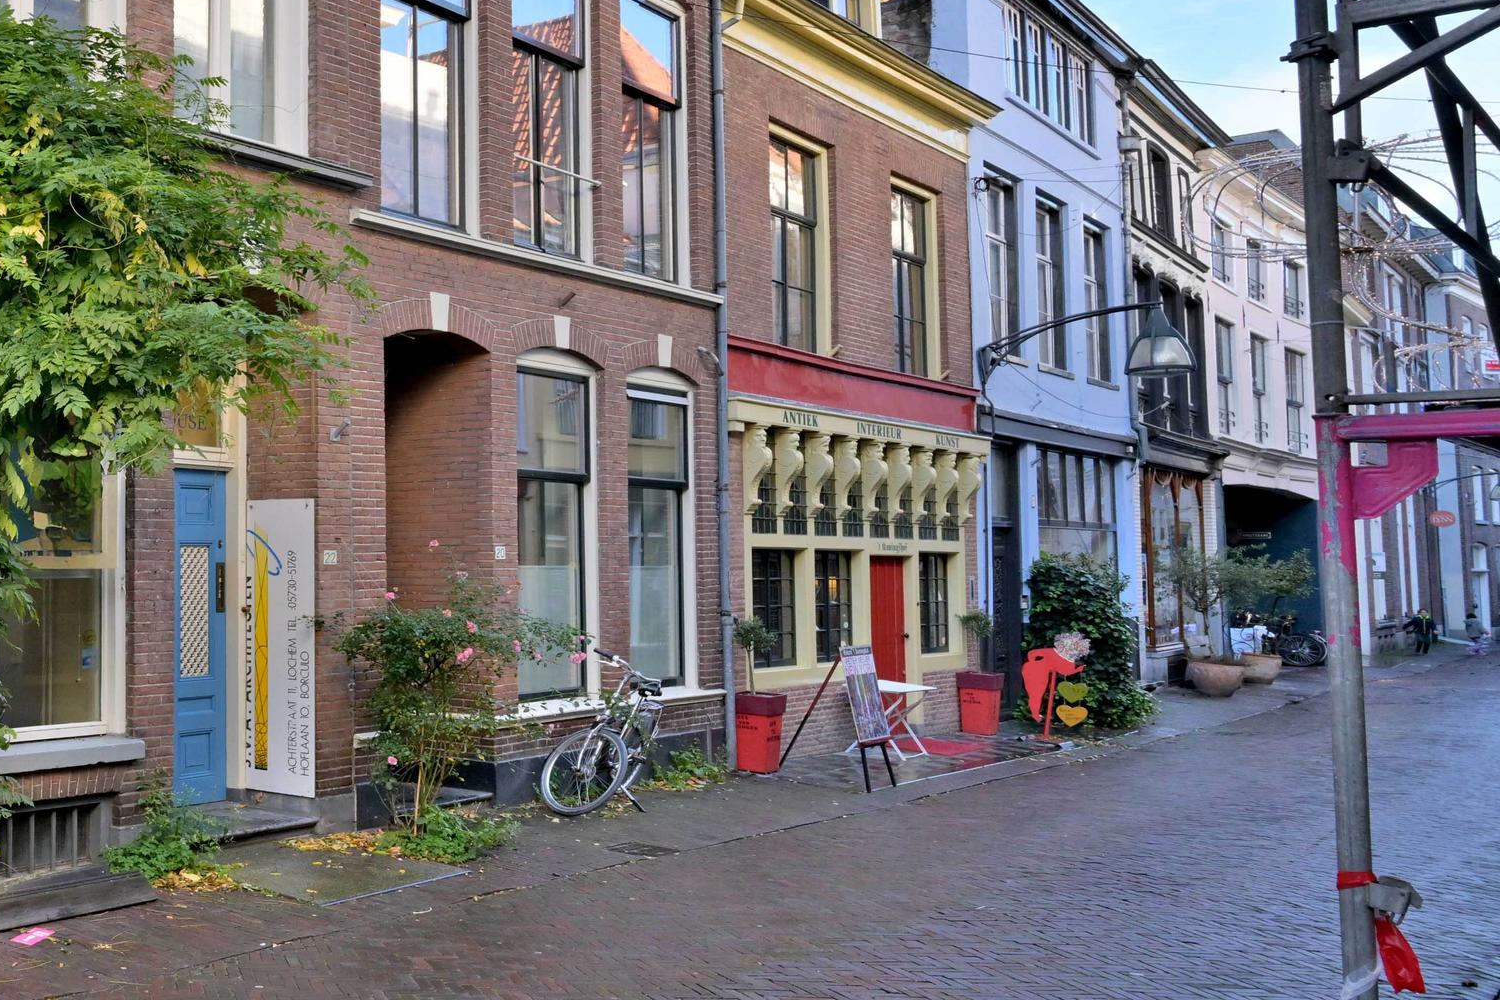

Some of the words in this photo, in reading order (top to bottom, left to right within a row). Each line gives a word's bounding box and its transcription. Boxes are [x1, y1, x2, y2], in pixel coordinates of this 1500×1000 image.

[782, 410, 818, 428] ANTIEK
[856, 422, 902, 440] INTERIEUR
[936, 434, 960, 448] KUNST
[324, 552, 336, 564] 22
[496, 547, 505, 559] 20
[288, 638, 297, 681] LOCHEM
[300, 650, 310, 699] BORCULO
[300, 724, 310, 776] HOFLAAN
